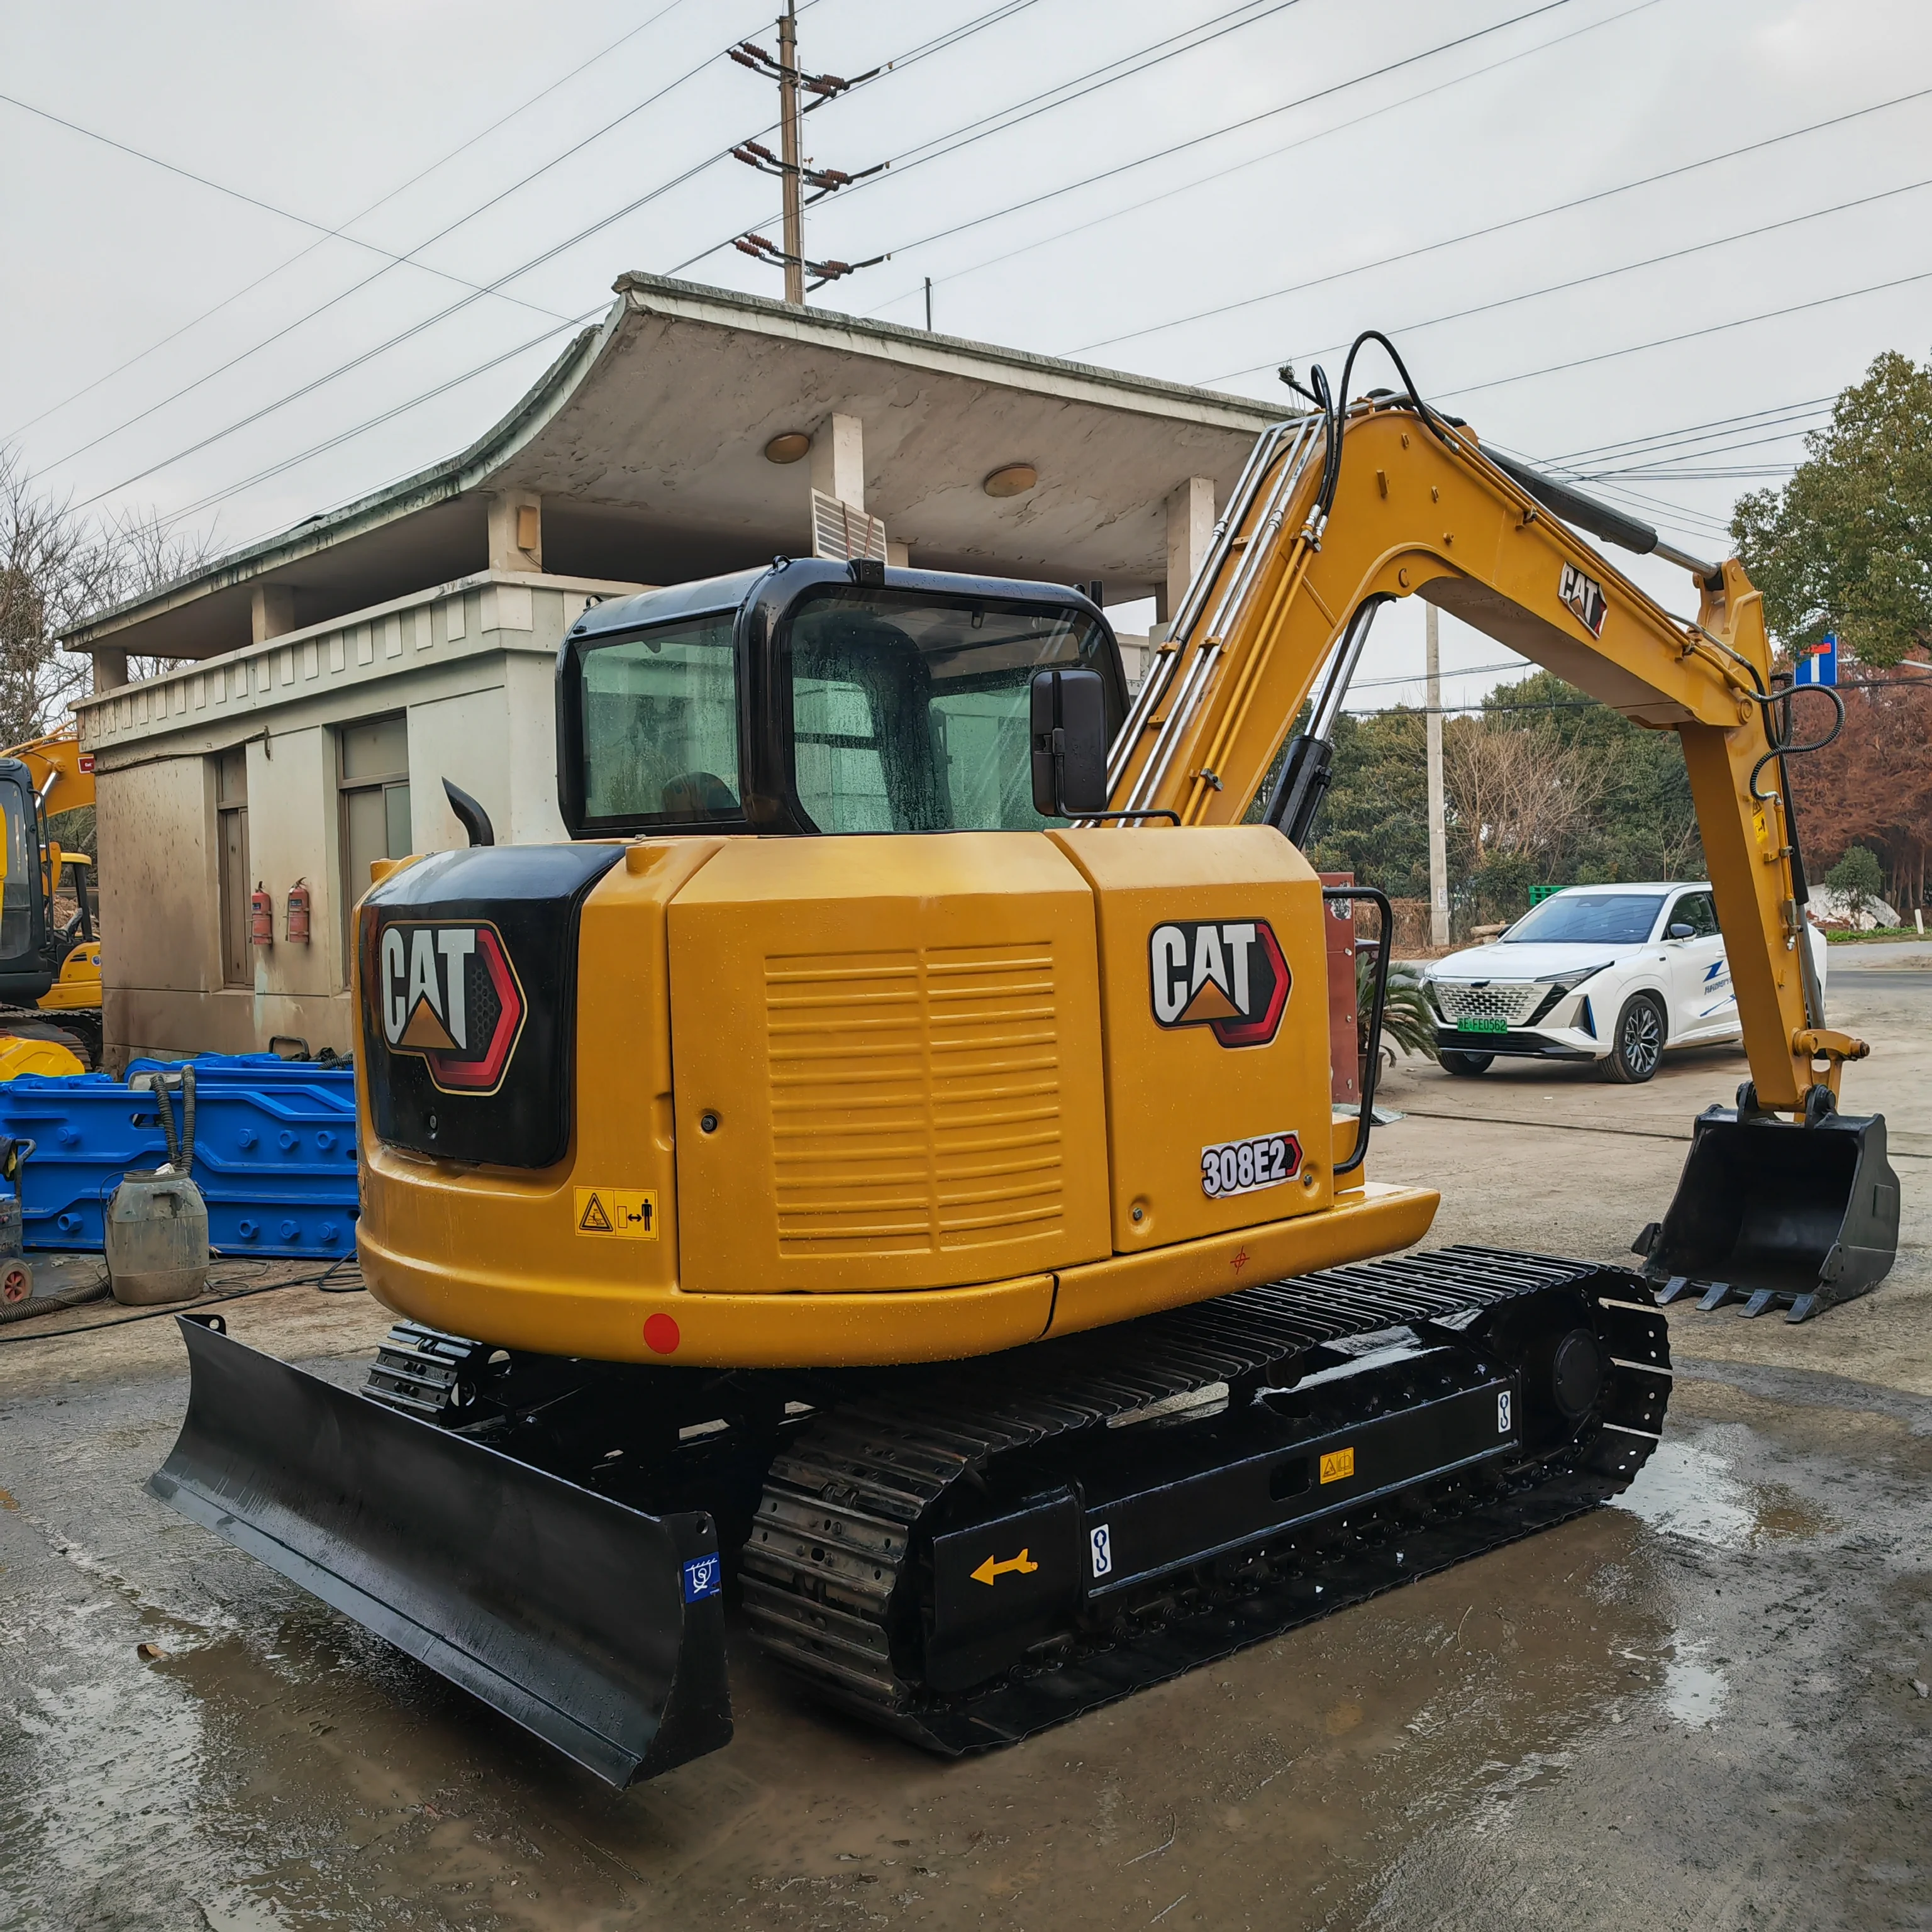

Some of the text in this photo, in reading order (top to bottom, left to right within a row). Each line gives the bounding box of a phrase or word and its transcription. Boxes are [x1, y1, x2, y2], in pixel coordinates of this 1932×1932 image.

[1559, 564, 1598, 625] CAT
[381, 928, 475, 1050] CAT
[1152, 923, 1255, 1023] CAT
[1202, 1138, 1287, 1194] 308E2
